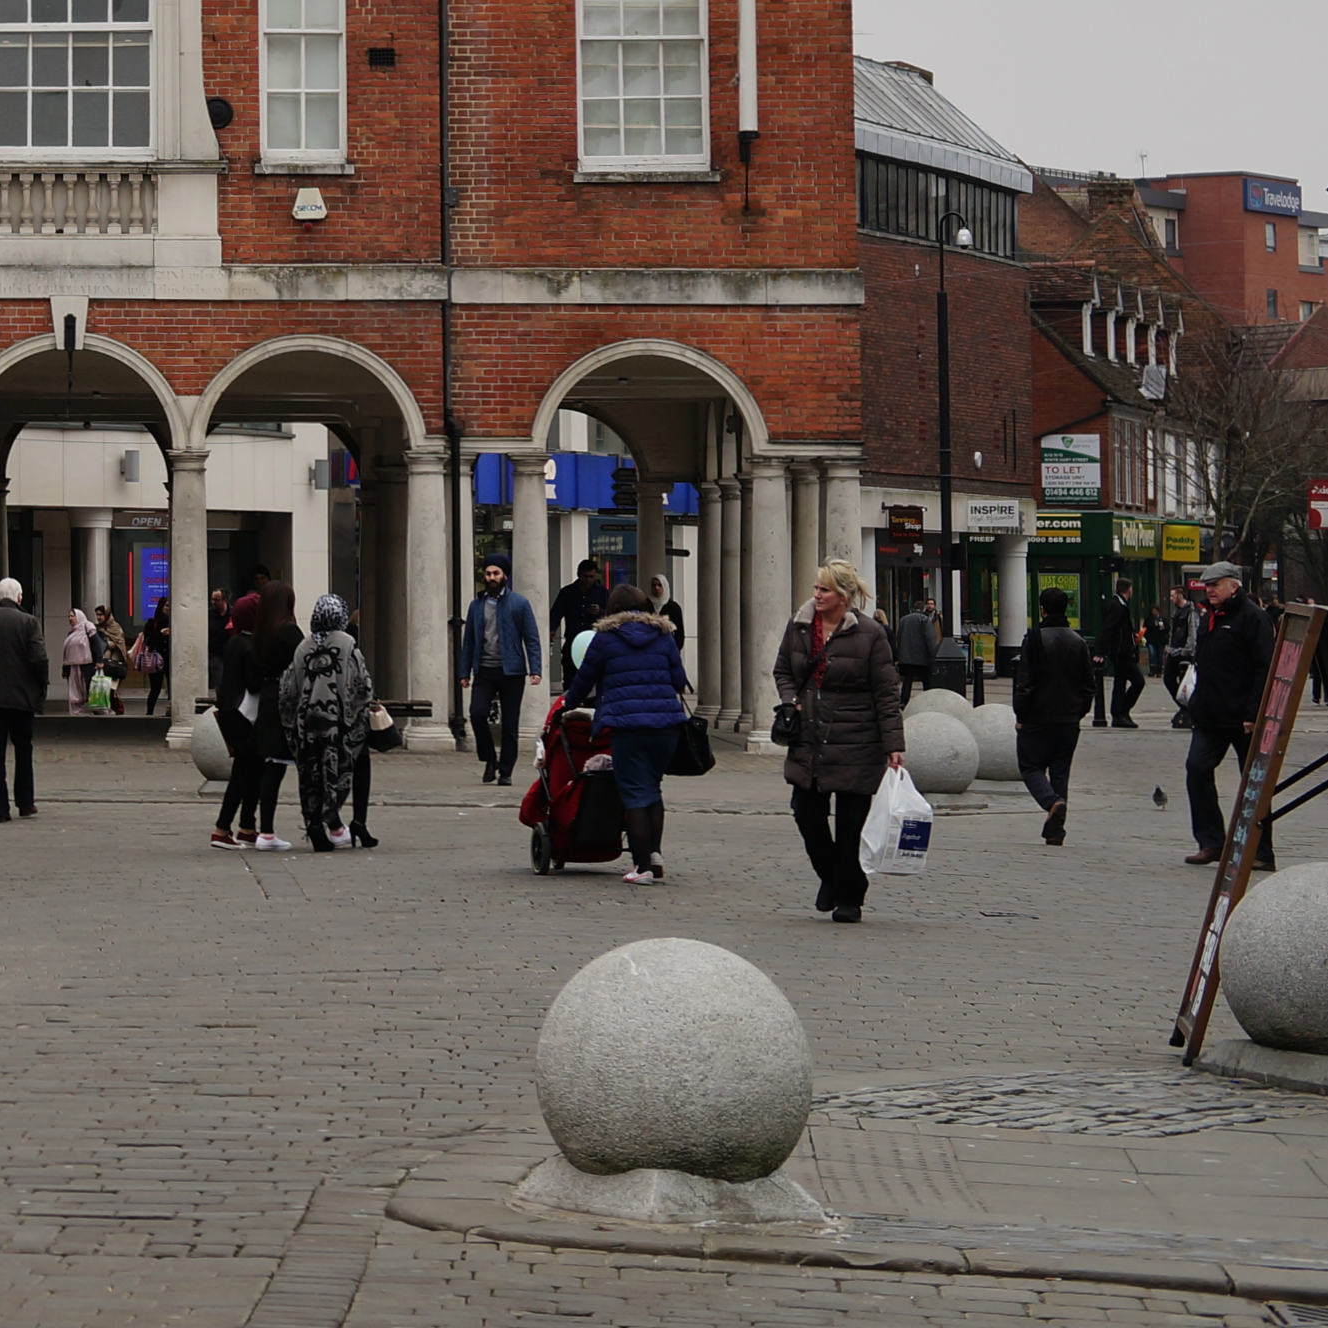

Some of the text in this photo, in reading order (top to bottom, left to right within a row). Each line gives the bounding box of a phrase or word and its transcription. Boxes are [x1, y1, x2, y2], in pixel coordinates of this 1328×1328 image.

[1263, 187, 1300, 212] Travelodge
[1045, 466, 1082, 474] TO LET
[1045, 488, 1098, 496] 01494 446 612
[970, 504, 1015, 515] INSPIRE
[131, 517, 162, 527] OPEN
[904, 522, 922, 531] Shop
[1165, 536, 1195, 545] Paddy
